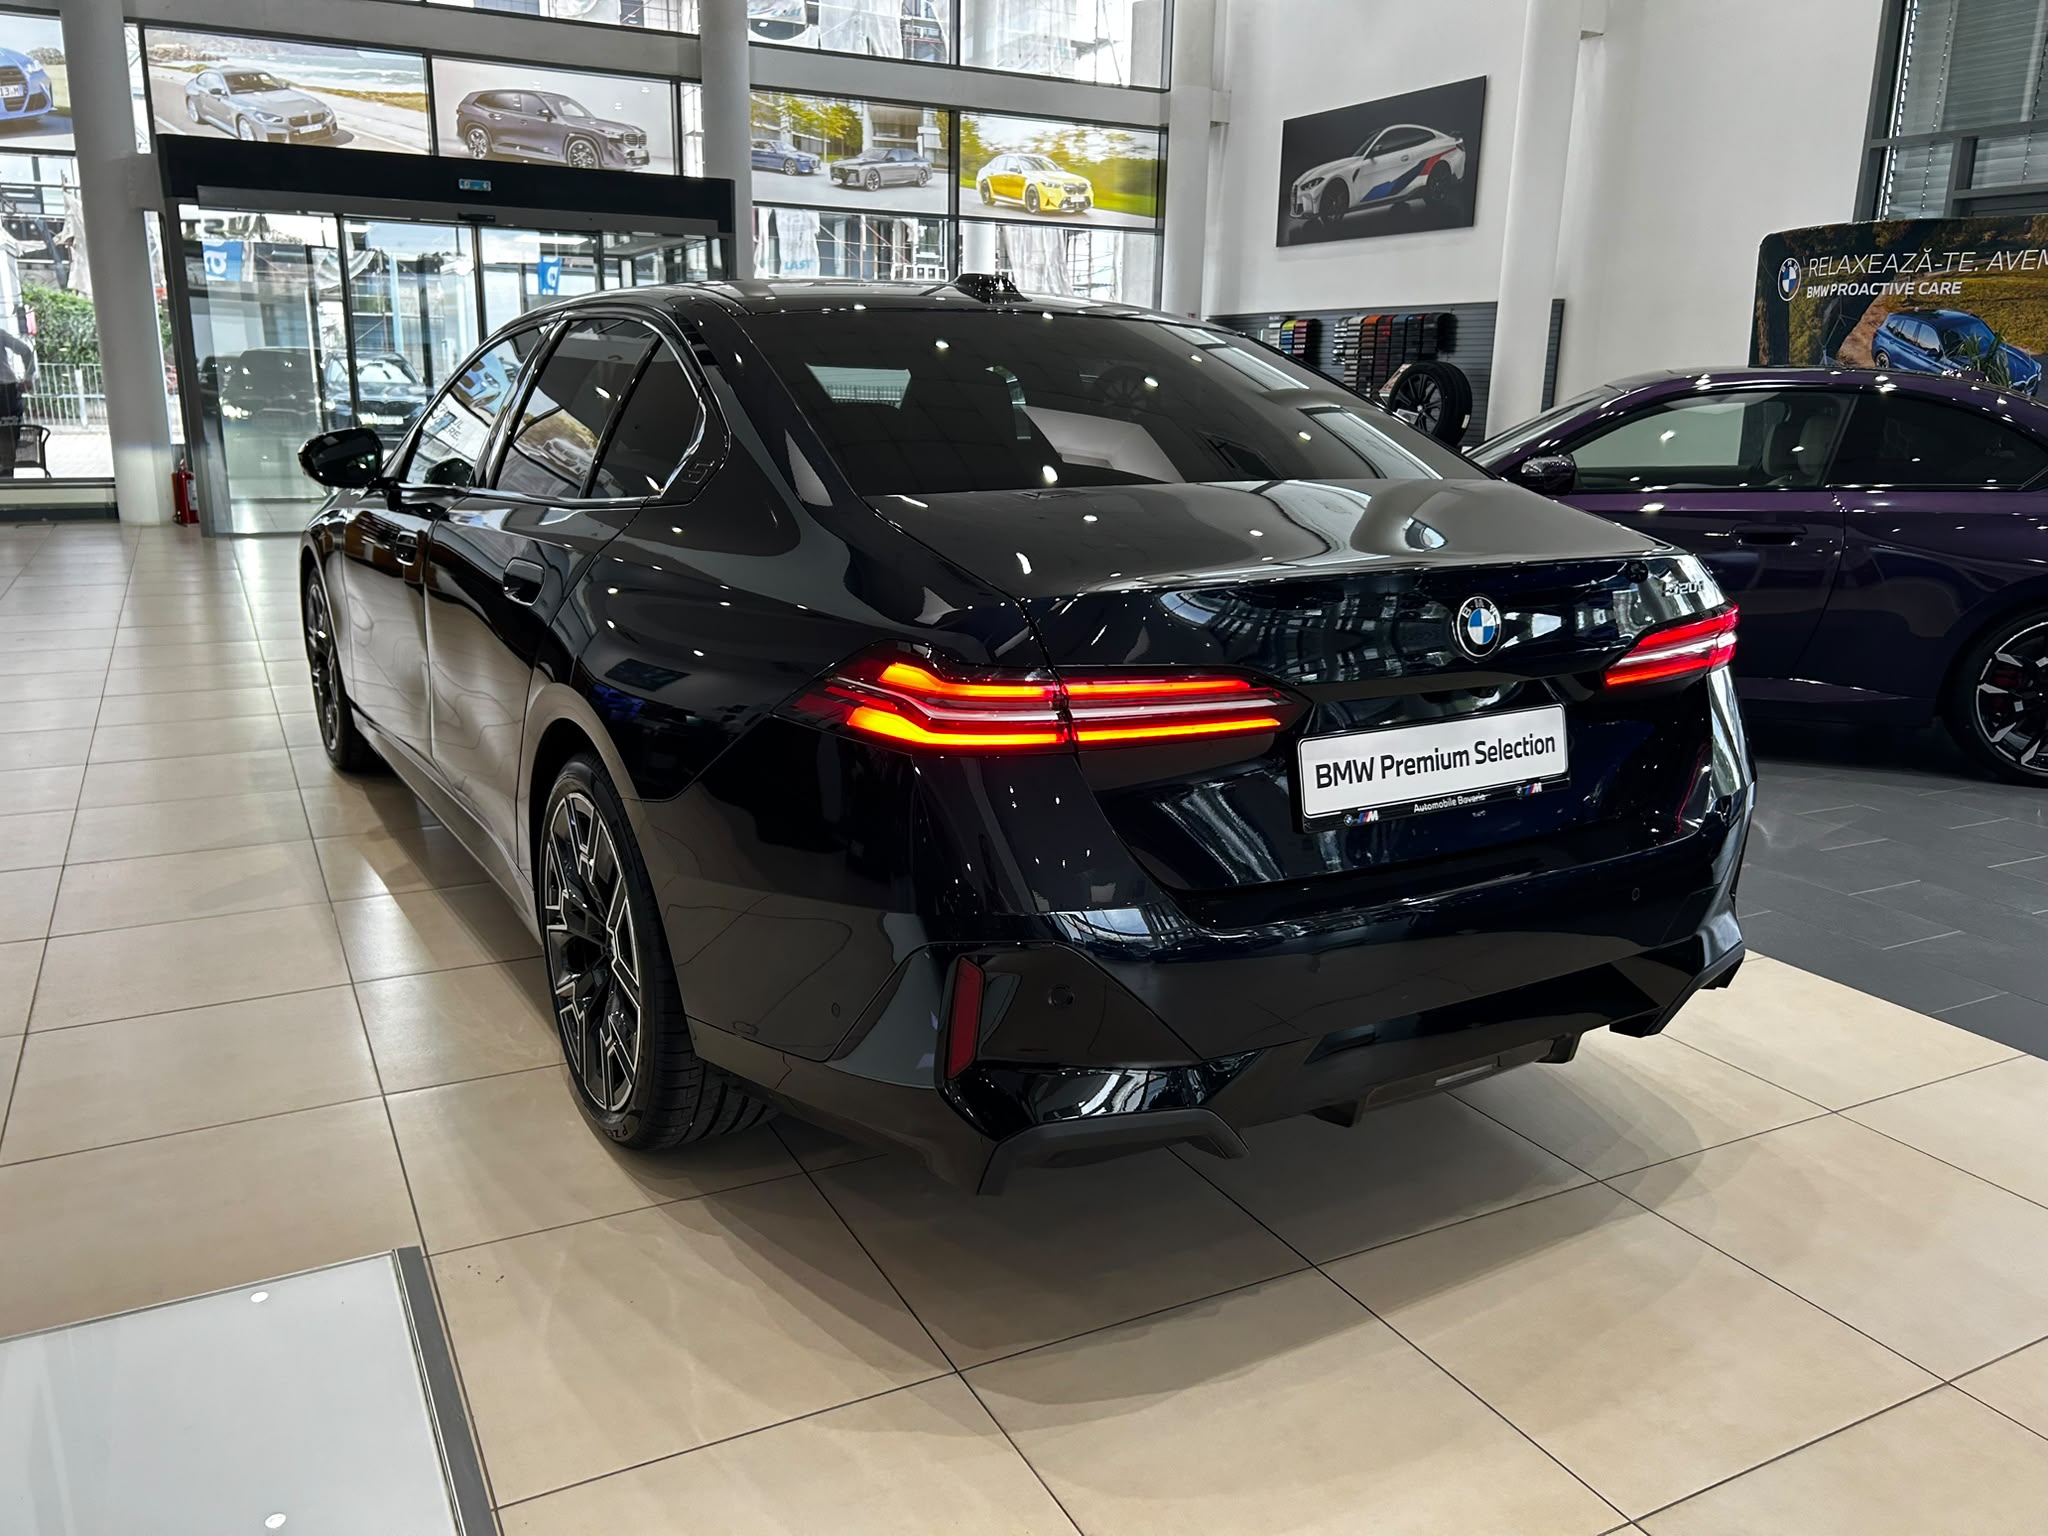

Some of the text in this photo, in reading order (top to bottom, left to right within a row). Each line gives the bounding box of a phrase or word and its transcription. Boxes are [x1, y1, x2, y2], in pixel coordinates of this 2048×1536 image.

[1808, 247, 1979, 278] RELAXEAZĂ-TE.
[1806, 281, 1963, 299] BMW PROACTIVE CARE
[1461, 598, 1501, 625] BMW
[1315, 733, 1556, 789] BMW Premium Selection
[1413, 797, 1457, 813] Automobile
